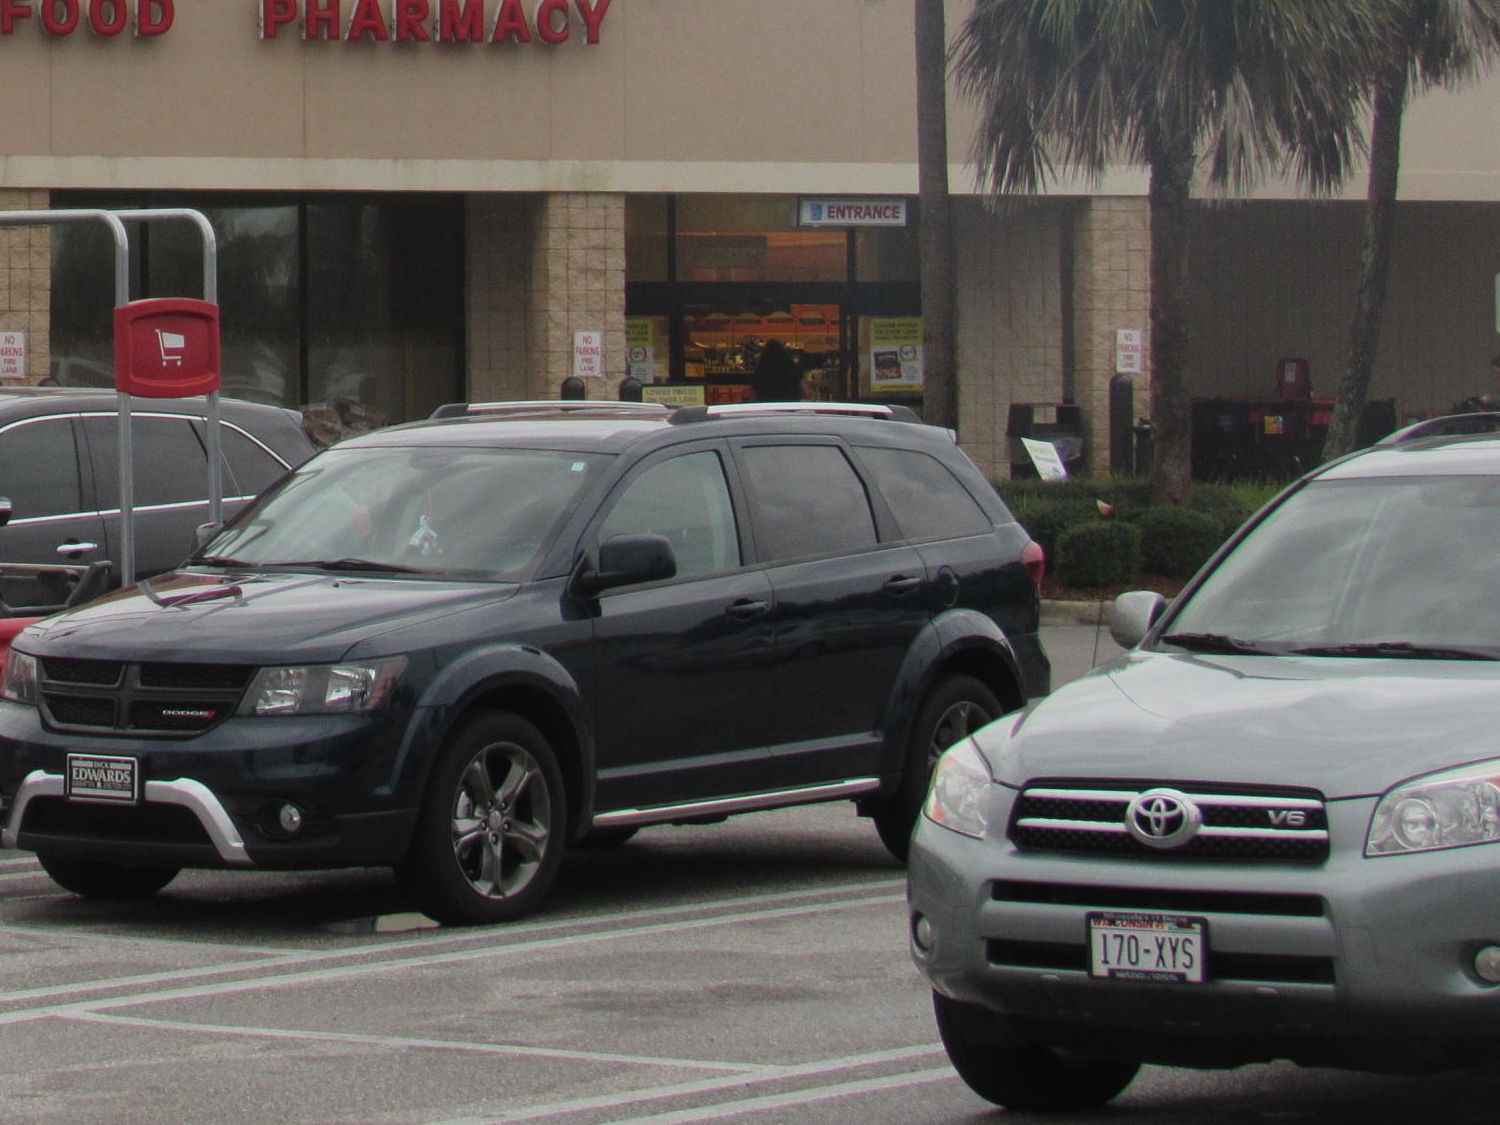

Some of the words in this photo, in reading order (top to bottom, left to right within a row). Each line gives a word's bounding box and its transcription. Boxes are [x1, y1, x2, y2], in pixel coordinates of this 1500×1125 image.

[827, 204, 901, 220] ENTRANCE
[4, 335, 16, 345] NO
[582, 335, 592, 345] NO
[575, 346, 600, 356] PARKING
[162, 709, 209, 717] DODGE
[92, 760, 111, 769] DICK
[72, 767, 132, 784] EDWARDS
[1267, 809, 1308, 826] V6
[1092, 918, 1154, 930] WISCONSIN
[1101, 933, 1194, 970] 170-XYS
